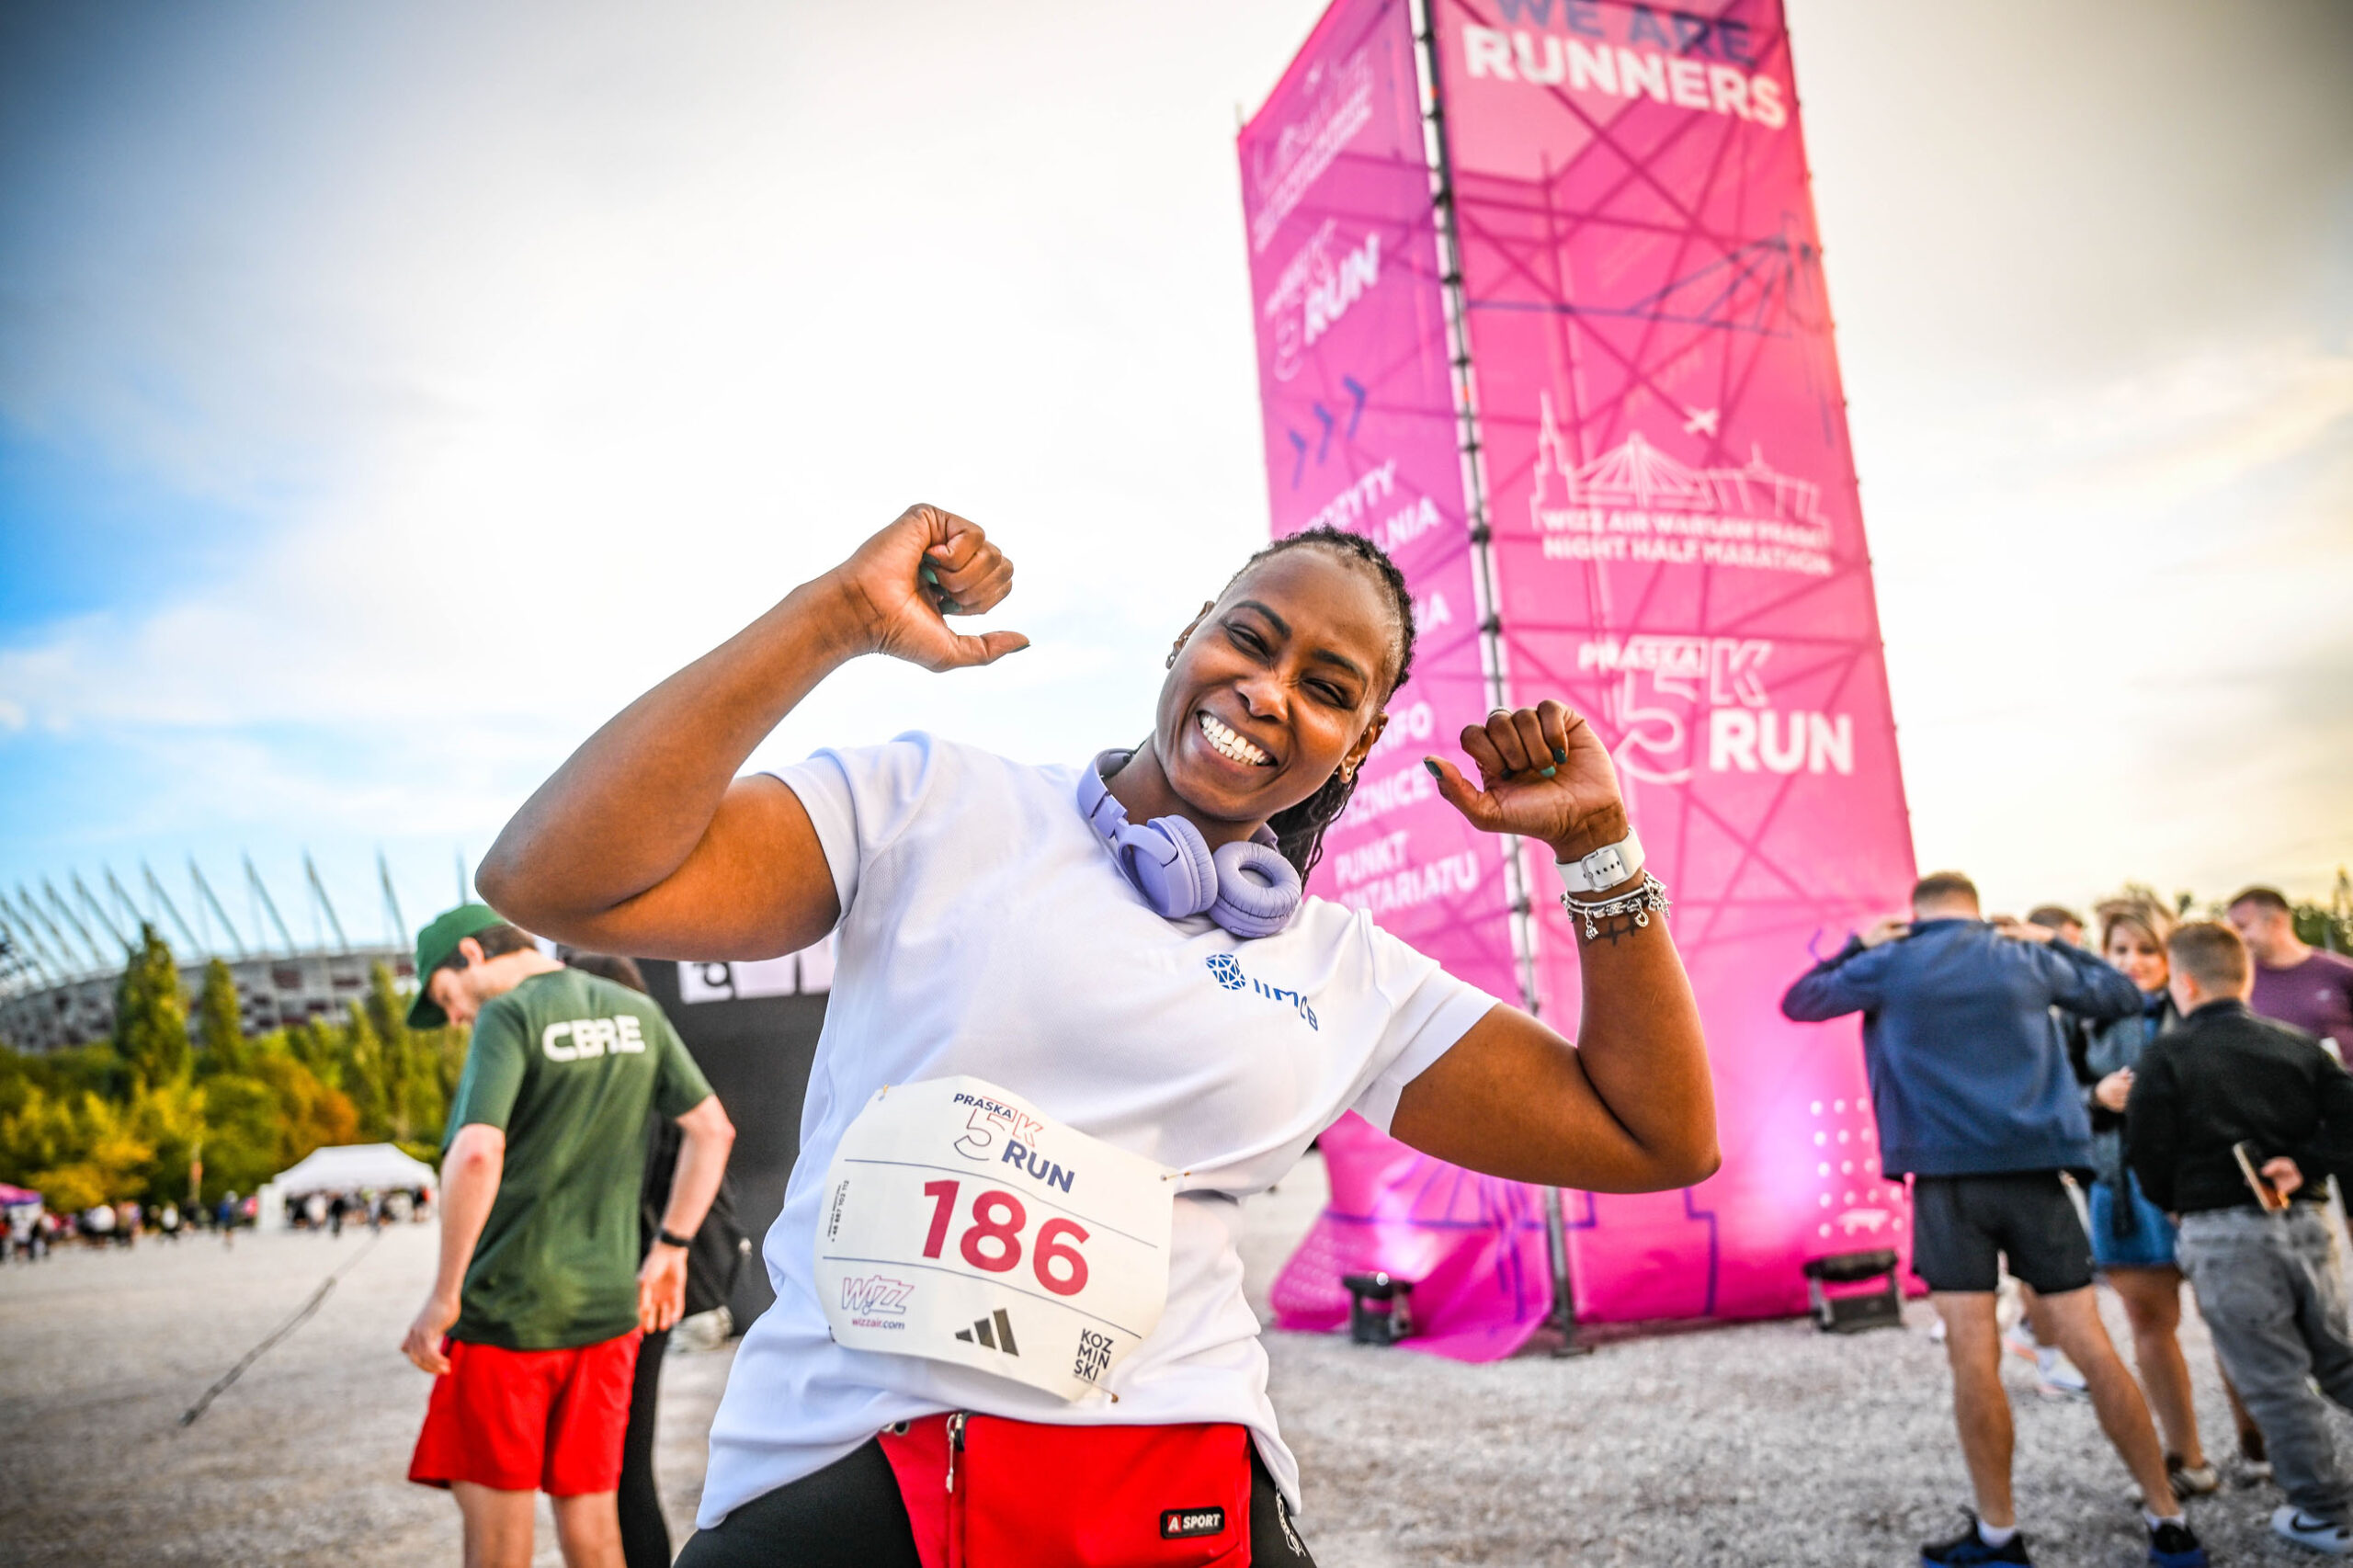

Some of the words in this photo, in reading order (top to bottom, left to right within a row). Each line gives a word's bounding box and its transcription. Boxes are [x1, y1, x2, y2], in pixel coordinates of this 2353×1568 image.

[1495, 0, 1605, 38] WE
[1629, 3, 1756, 70] ARE
[1461, 23, 1787, 131] RUNNERS
[1304, 232, 1380, 347] RUN
[1543, 535, 1626, 561] NIGHT
[1631, 537, 1699, 564] HALF
[1709, 708, 1853, 775] RUN
[1336, 831, 1408, 889] PUNKT
[542, 1015, 646, 1062] CBRE
[953, 1093, 1012, 1119] PRASKA
[1001, 1138, 1075, 1194] RUN
[922, 1179, 1090, 1296] 186
[852, 1317, 905, 1330] wizzair.com
[1081, 1328, 1114, 1355] KOZ
[1074, 1358, 1098, 1381] SKI
[1077, 1343, 1110, 1369] MIN
[1167, 1516, 1180, 1531] A
[1183, 1513, 1222, 1529] SPORT
